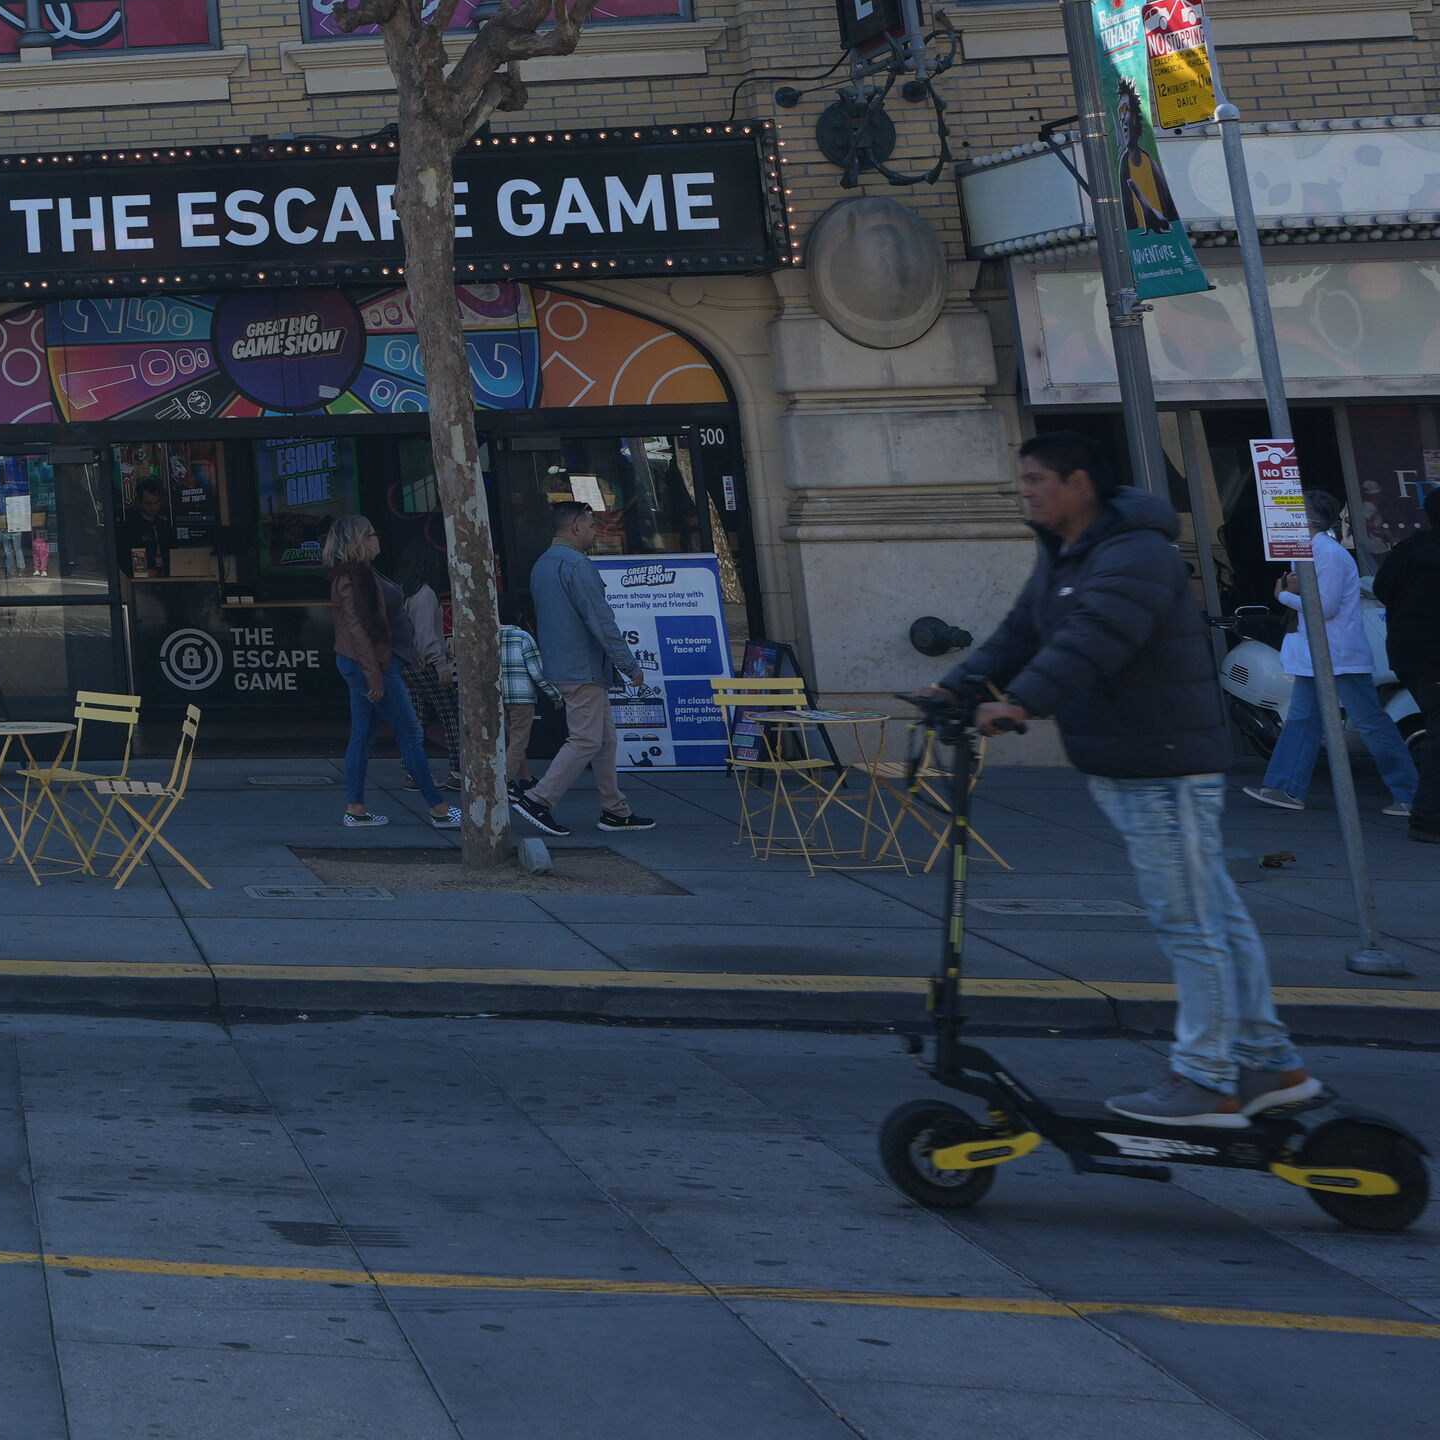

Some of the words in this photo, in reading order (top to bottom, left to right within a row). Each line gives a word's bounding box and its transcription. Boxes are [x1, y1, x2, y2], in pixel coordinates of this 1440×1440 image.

[1098, 5, 1140, 30] Fisherman's
[1100, 18, 1140, 50] WHARF
[1148, 33, 1166, 57] NO
[1167, 26, 1205, 53] STOPPING
[1177, 95, 1197, 108] DAILY
[10, 193, 154, 255] THE
[496, 172, 721, 236] GAME
[1133, 245, 1177, 265] ADVENTURE
[246, 318, 287, 338] GREAT
[287, 314, 319, 336] BIG
[232, 334, 283, 360] GAME
[283, 328, 343, 356] SHOW
[277, 440, 337, 476] ESCAPE
[1262, 469, 1280, 478] NO
[286, 472, 332, 506] GAME
[621, 574, 647, 586] GAME
[647, 571, 674, 585] SHOW
[628, 566, 647, 575] GREAT
[648, 565, 663, 574] BIG
[606, 593, 628, 601] game
[630, 592, 651, 600] show
[652, 593, 667, 601] you
[668, 591, 684, 600] play
[686, 590, 704, 598] with
[626, 601, 651, 610] family
[230, 627, 274, 646] THE
[665, 637, 683, 645] Two
[685, 637, 712, 645] teams
[233, 649, 319, 668] ESCAPE
[694, 645, 707, 653] off
[234, 672, 297, 691] GAME
[674, 707, 697, 715] game
[675, 715, 724, 723] mini-game
